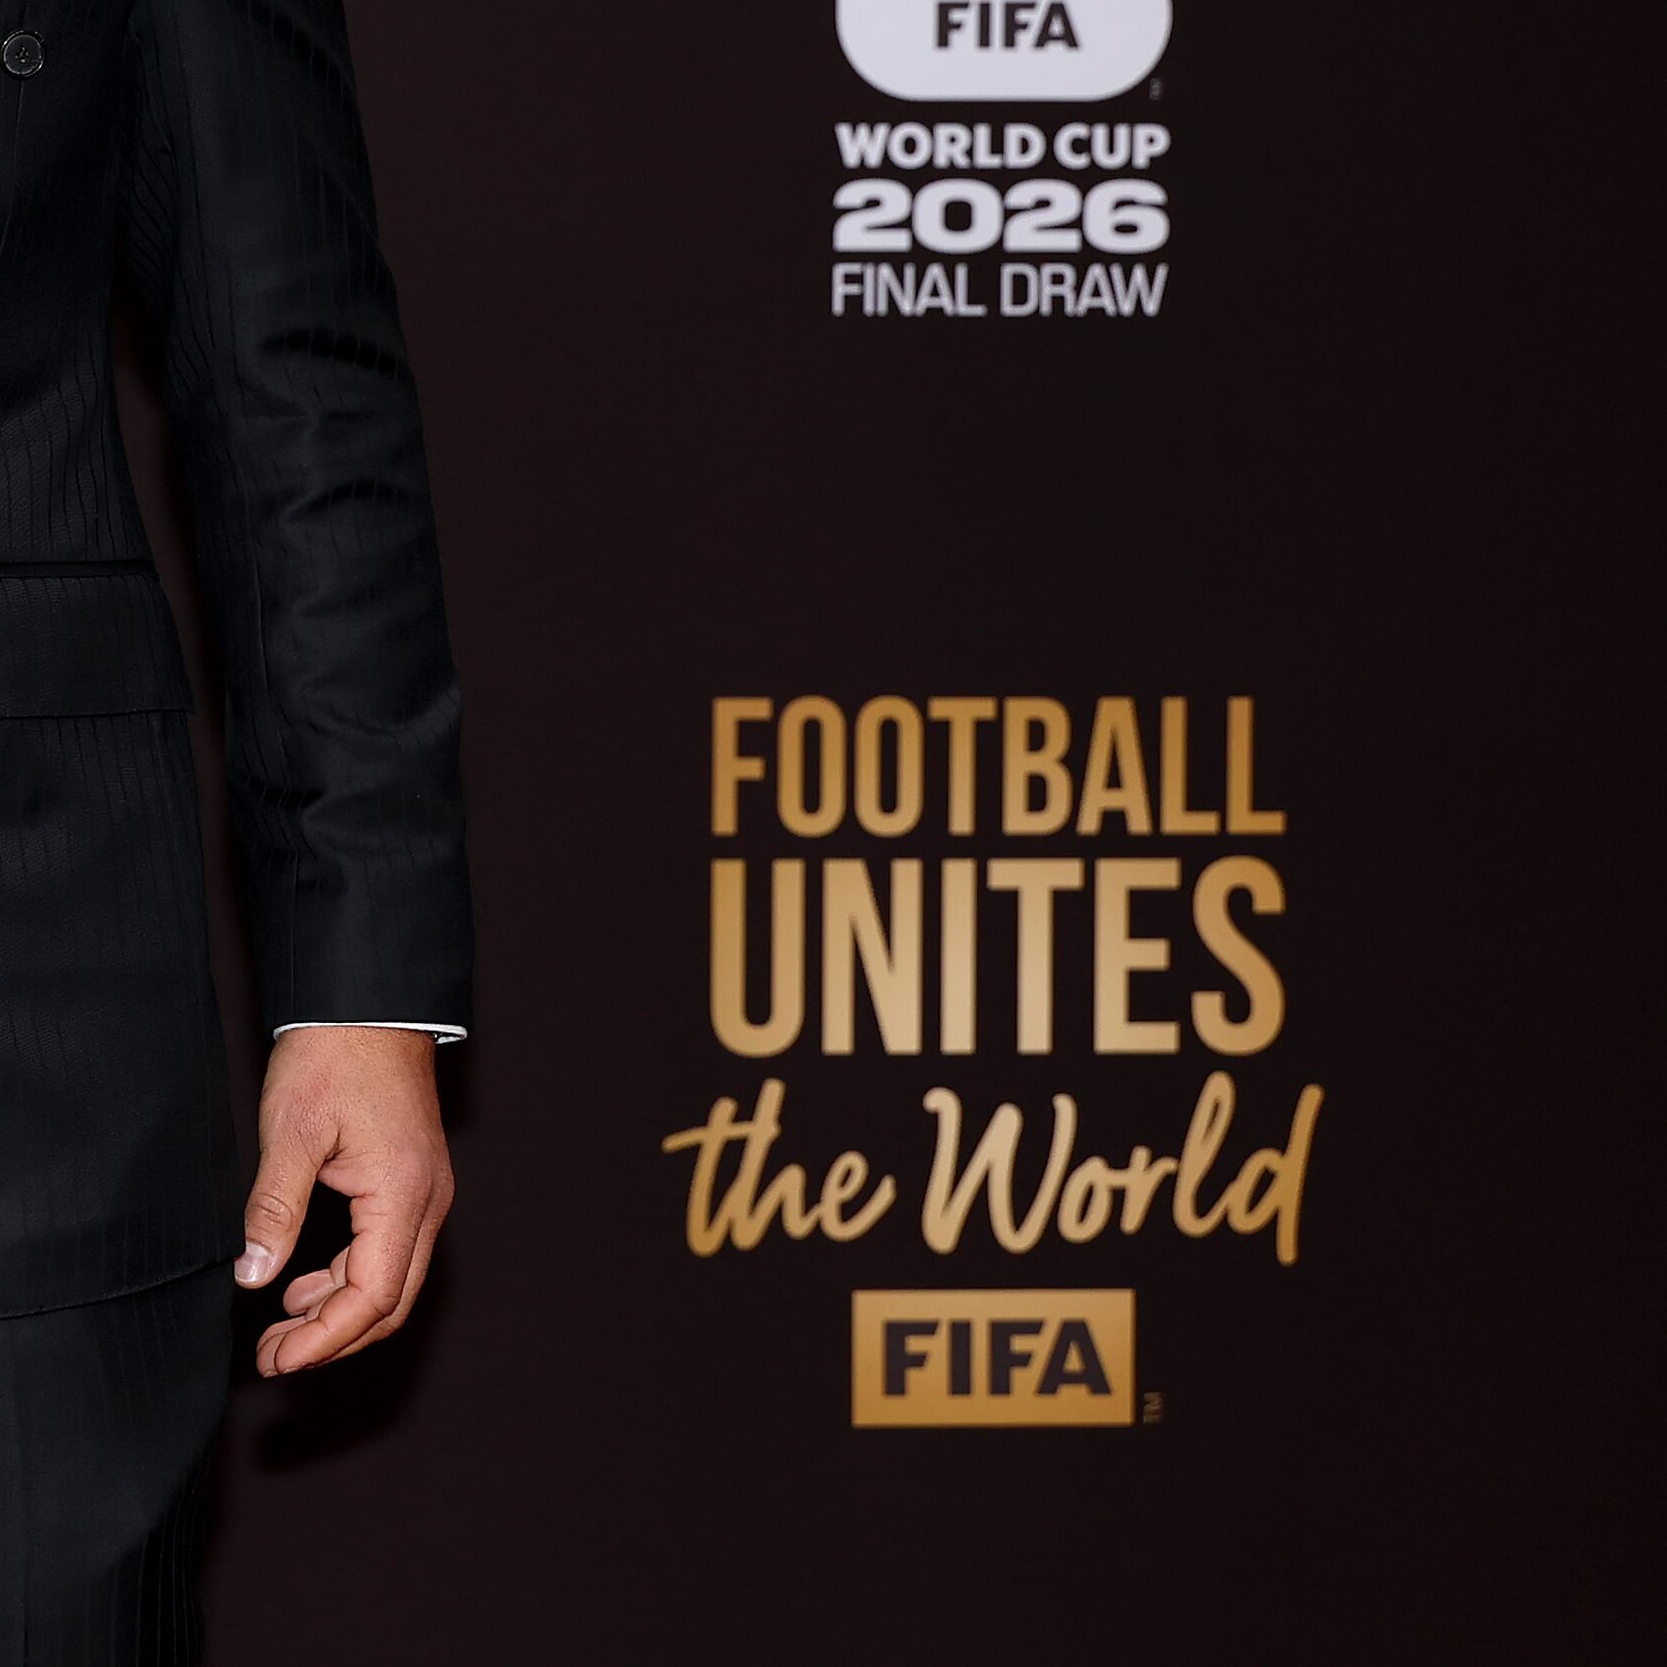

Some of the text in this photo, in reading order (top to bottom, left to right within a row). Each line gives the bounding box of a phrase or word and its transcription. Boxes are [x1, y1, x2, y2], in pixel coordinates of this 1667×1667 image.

[937, 1, 1079, 48] FIFA
[835, 123, 1170, 169] WORLD CUP
[834, 179, 1169, 253] 2026
[832, 263, 1168, 316] FINAL DRAW
[712, 696, 1285, 837] FOOTBALL
[711, 857, 1284, 1056] UNITES
[663, 1072, 1323, 1263] the World
[884, 1320, 1112, 1396] FIFA
